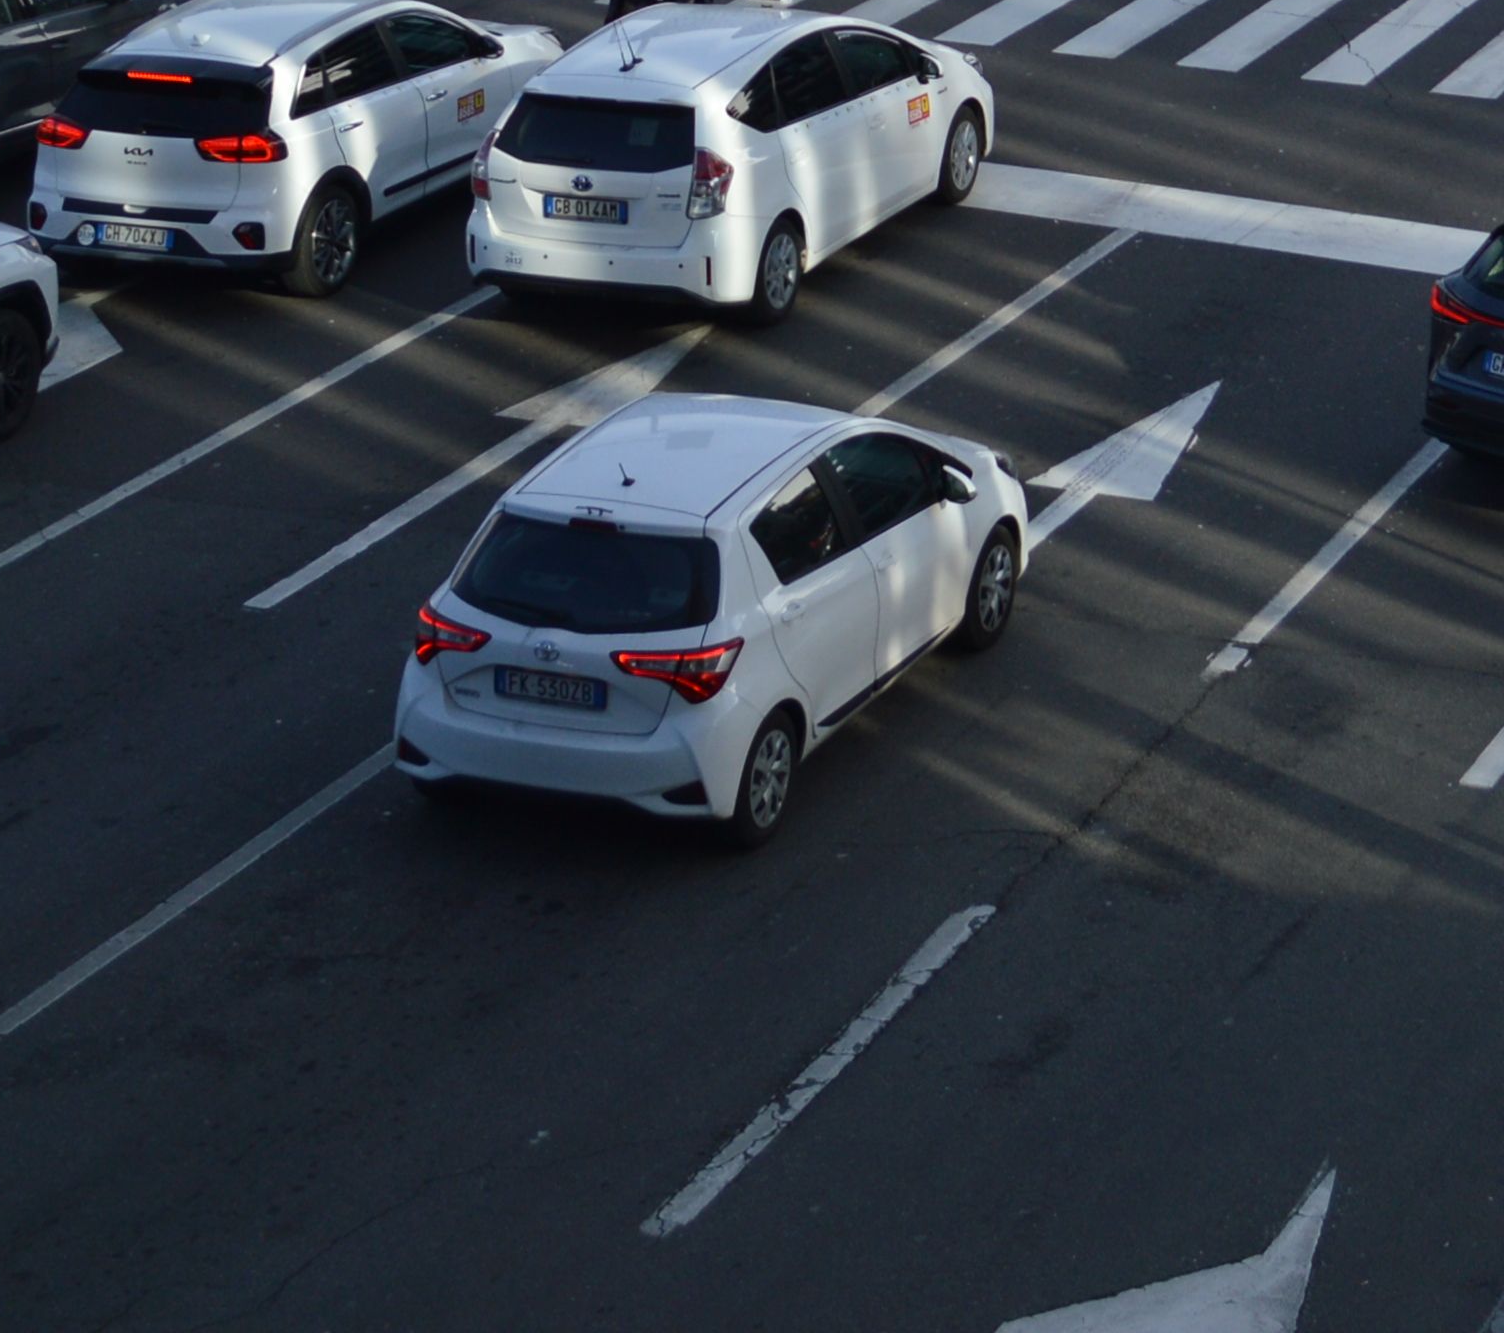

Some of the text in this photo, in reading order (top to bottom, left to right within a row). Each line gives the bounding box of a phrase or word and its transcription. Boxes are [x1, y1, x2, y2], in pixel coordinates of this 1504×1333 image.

[554, 198, 619, 219] GB 014AM
[105, 223, 121, 241] GH
[124, 226, 166, 246] 704XJ
[507, 670, 529, 695] FK
[536, 674, 594, 704] 530ZB
